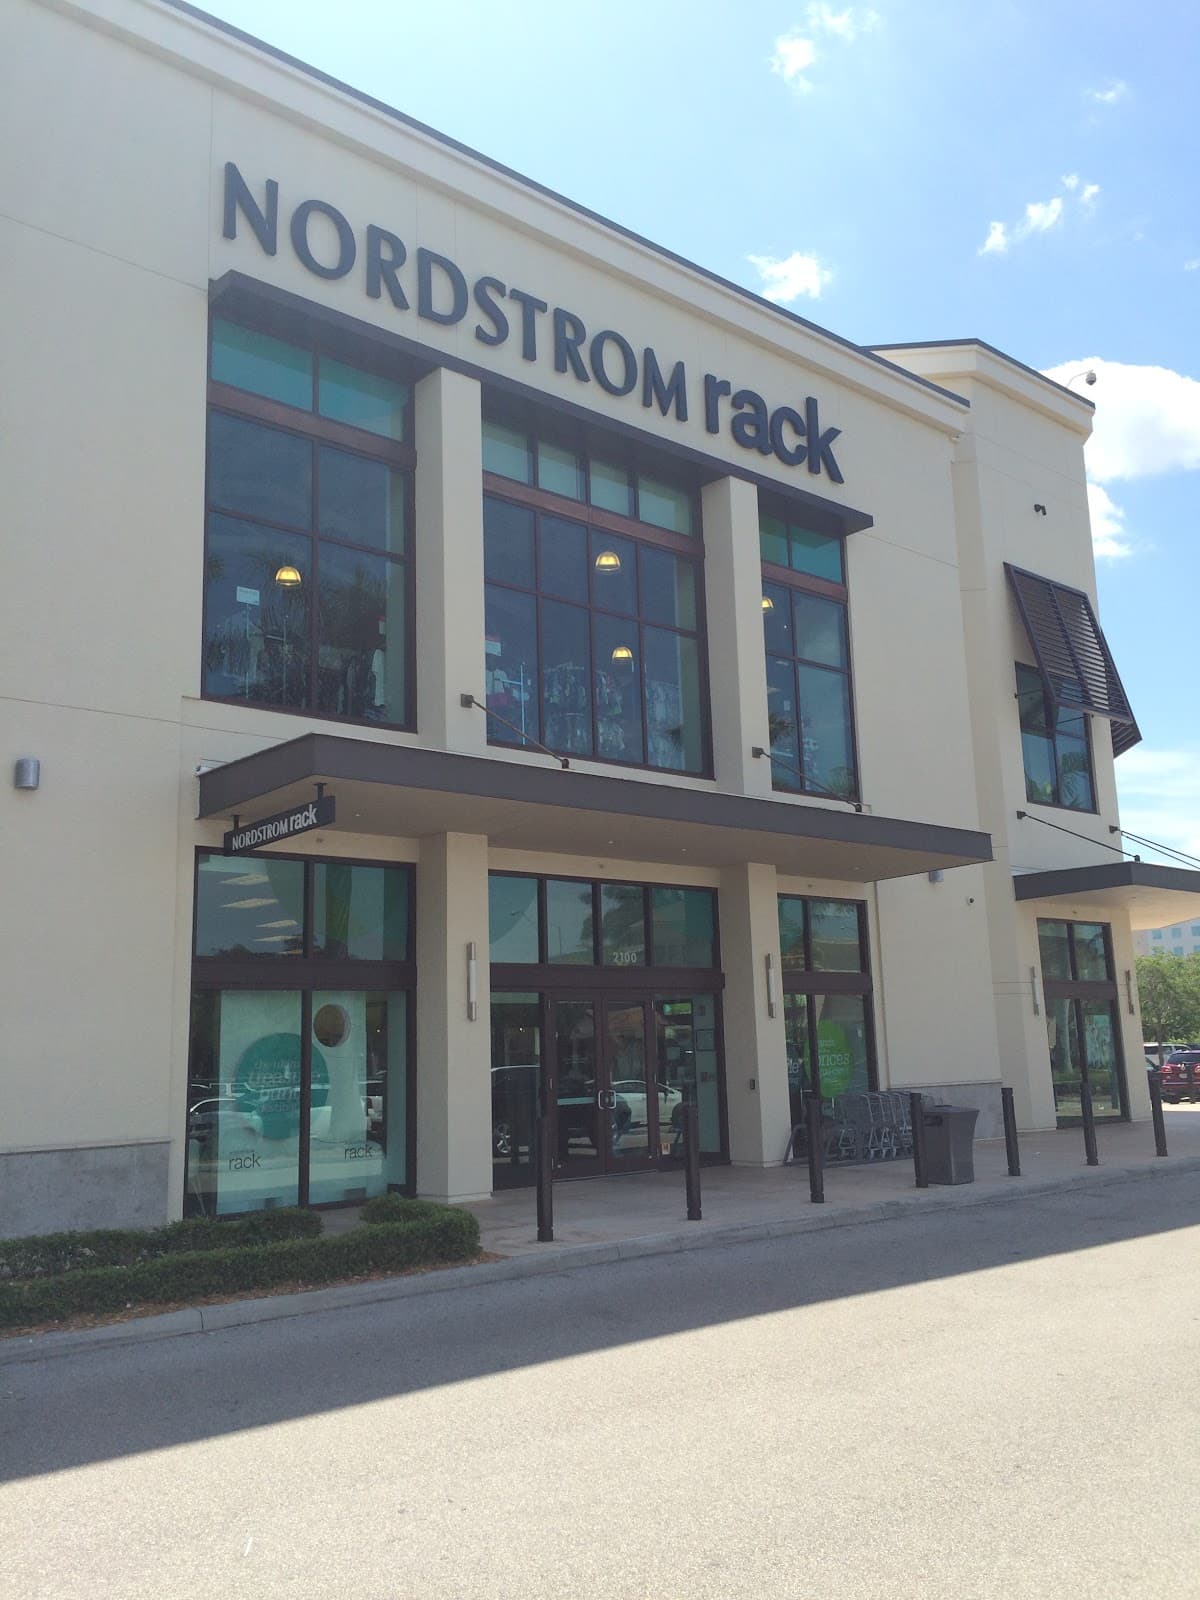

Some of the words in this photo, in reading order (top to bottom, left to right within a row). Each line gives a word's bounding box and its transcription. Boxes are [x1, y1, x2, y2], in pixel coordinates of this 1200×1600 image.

[222, 161, 688, 423] NORDSTROM
[703, 374, 845, 485] rack
[232, 818, 287, 851] NORDSTROM
[290, 804, 318, 831] rack
[612, 951, 638, 964] 2100
[344, 1144, 372, 1159] rack
[229, 1152, 261, 1170] rack
